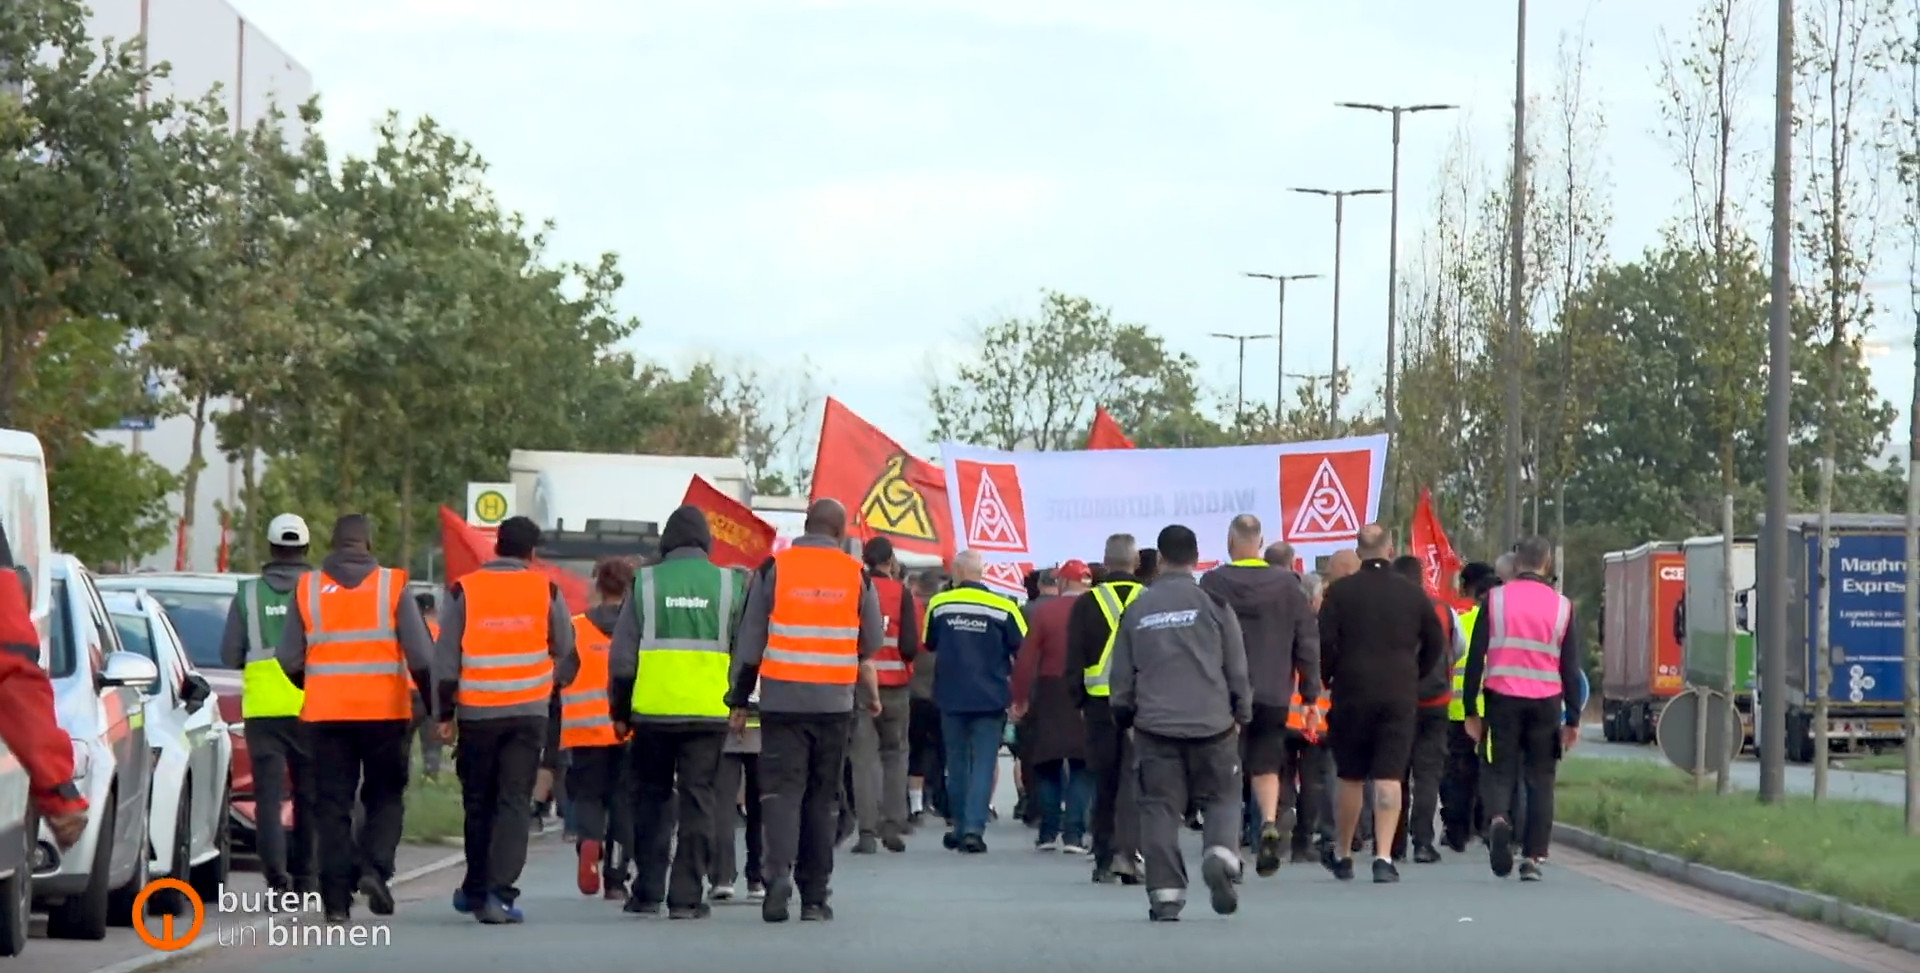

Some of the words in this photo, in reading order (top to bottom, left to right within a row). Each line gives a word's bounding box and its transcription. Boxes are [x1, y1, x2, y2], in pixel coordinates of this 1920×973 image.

[484, 498, 498, 516] H
[1841, 557, 1907, 575] Maghr
[1842, 578, 1906, 596] Expres
